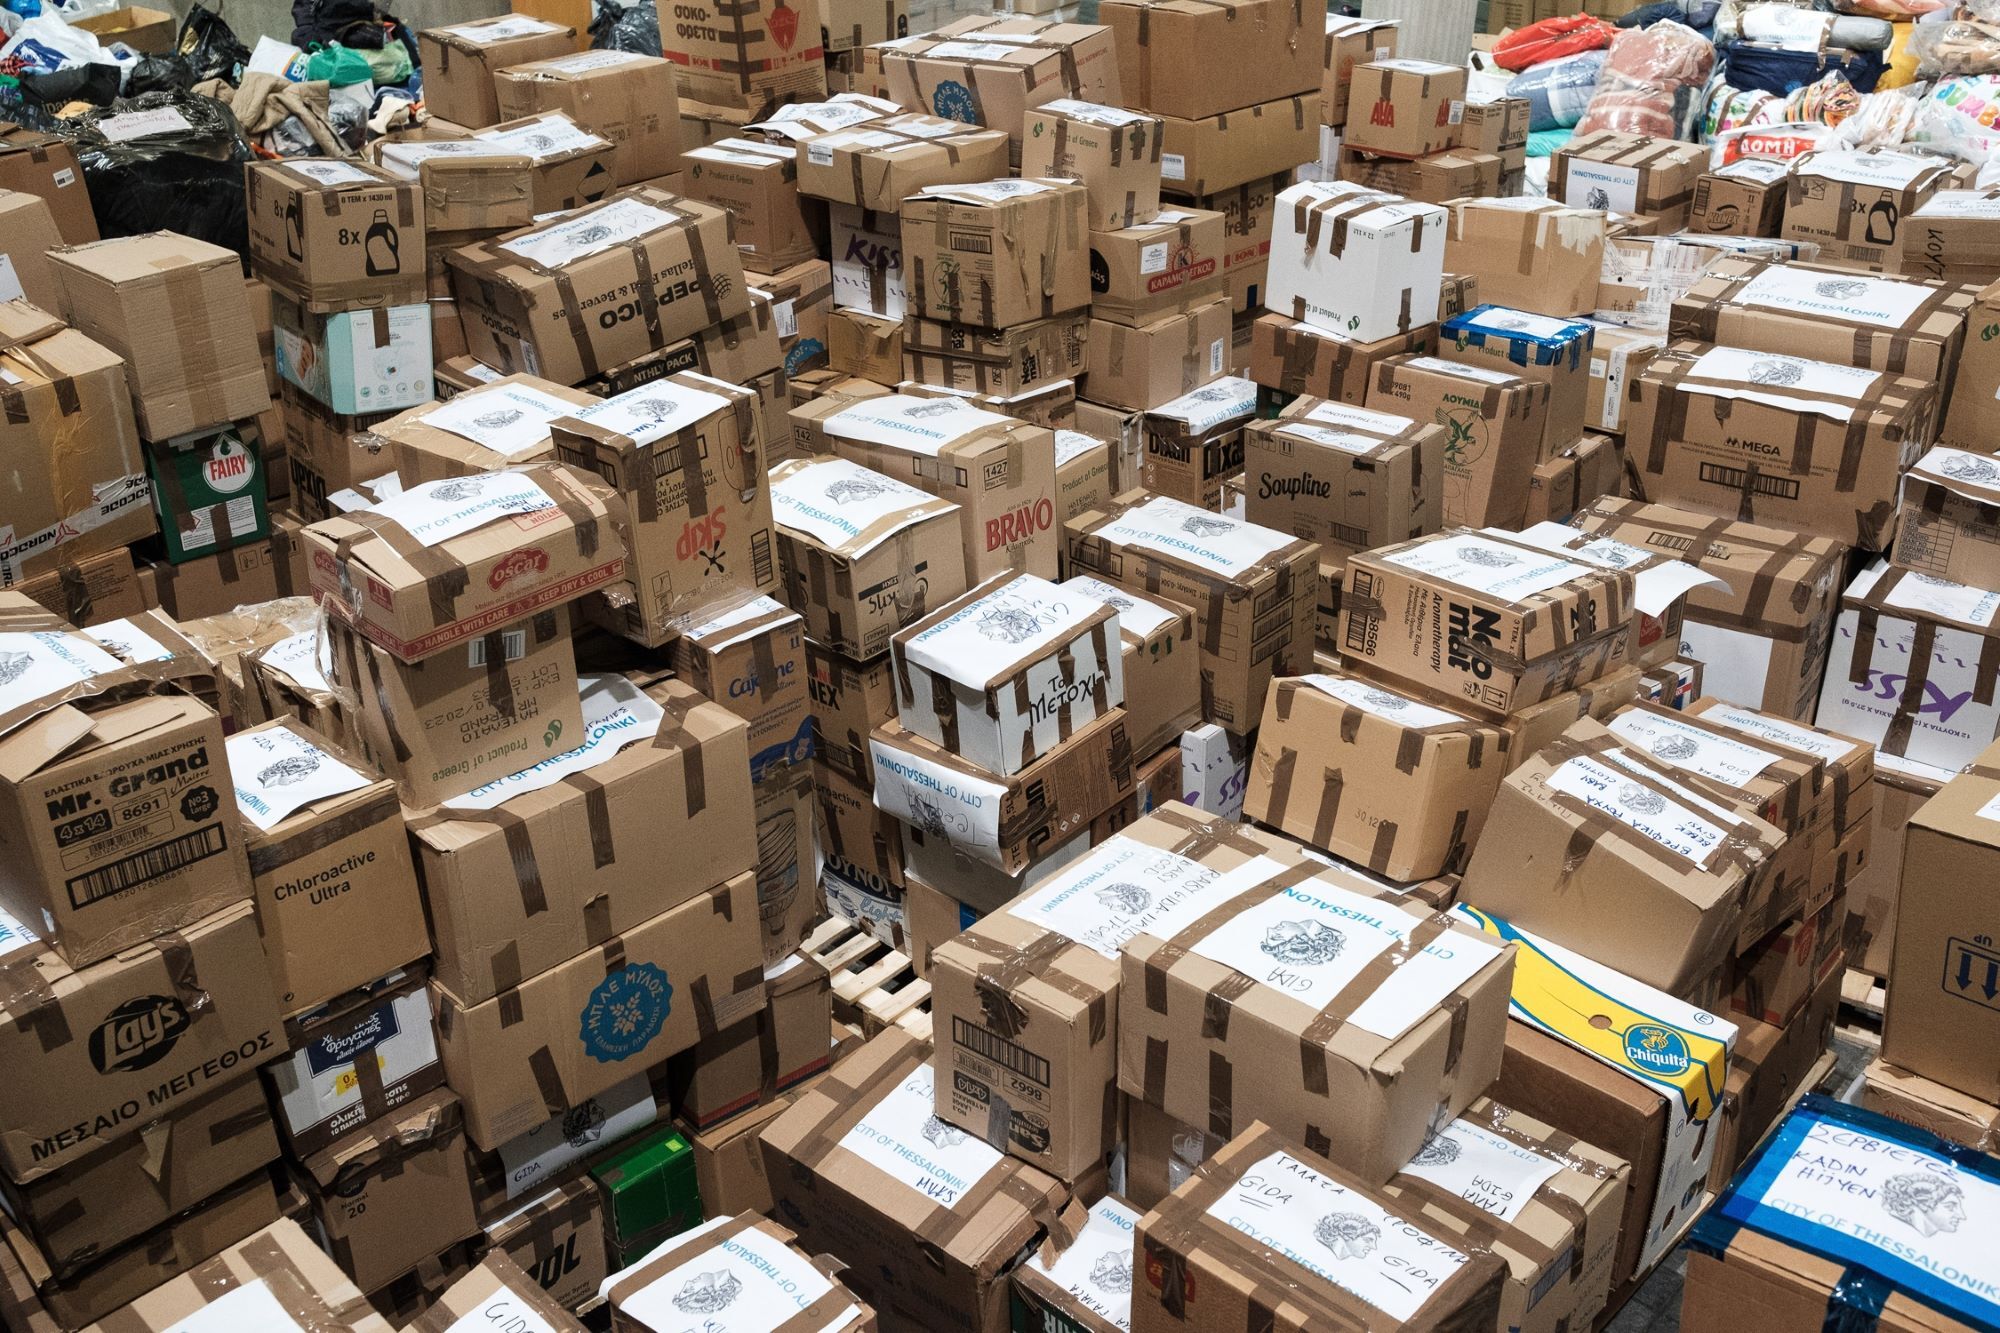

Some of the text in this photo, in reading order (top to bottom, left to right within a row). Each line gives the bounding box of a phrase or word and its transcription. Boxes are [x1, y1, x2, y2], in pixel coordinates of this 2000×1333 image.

[1078, 135, 1099, 149] Greece
[1571, 168, 1635, 186] CITY THESSALONIKI
[339, 228, 360, 245] 8x
[514, 214, 590, 248] THESSALONIKI
[1367, 232, 1375, 240] 12
[1815, 228, 1830, 237] 1430
[1149, 261, 1215, 292] ΚΑΡΑΜΟΕΓΚΟΣ
[599, 279, 705, 330] PEPICO
[617, 287, 628, 301] &
[1746, 292, 1892, 320] CITY OF THESSALONIKI
[1320, 309, 1341, 323] Product
[665, 351, 694, 374] PACK
[860, 415, 873, 428] OF
[873, 416, 948, 440] THESSALONIKI
[1741, 440, 1782, 457] MEGA
[209, 454, 248, 481] FAIRY
[985, 461, 1008, 478] 1427
[1062, 472, 1086, 494] Product
[1258, 471, 1332, 501] Soupline
[434, 488, 543, 529] OF THESSALONIKI
[782, 493, 862, 539] OF THESSALONIK
[985, 498, 1053, 553] BRAVO
[1113, 525, 1234, 567] CITY OF THESSALONIKI
[538, 588, 559, 604] KEEP
[560, 580, 579, 596] DRY
[587, 569, 609, 587] COOL
[1008, 574, 1029, 594] CITY
[1484, 576, 1523, 595] CITY OF
[424, 607, 511, 650] HANDLE WITH CARE
[916, 595, 994, 644] THESSALONIKI
[1431, 592, 1444, 674] Aromatherapy
[531, 671, 561, 692] EXP:
[1929, 723, 1960, 738] ΚΟΥΤΙΑ
[470, 714, 638, 798] CITY OF THESSALONIKI
[488, 737, 528, 765] Product
[44, 774, 92, 798] ΕΛΑΣΤΙΚΑ
[146, 750, 169, 766] ΜΙΑΣ
[168, 735, 208, 760] ΧΡΗΣΗΣ
[431, 759, 471, 784] Greece
[875, 752, 944, 794] THESSALONIKI
[1568, 758, 1617, 786] CLOTHES
[47, 748, 210, 821] Mr. Grand
[944, 782, 960, 799] OF
[1578, 775, 1609, 793] BABY
[121, 798, 162, 822] 8691
[960, 789, 984, 810] CITY
[58, 814, 108, 841] 4x14
[273, 849, 376, 899] Chloroactive
[309, 878, 351, 907] Ultra
[1041, 871, 1104, 914] THESSALONIKI
[1973, 934, 1993, 948] UP
[1265, 967, 1313, 993] GIDA
[587, 971, 665, 1029] ΜΠΛΕ ΜΥΛΟΣ
[1626, 1044, 1689, 1070] Chiquita
[31, 1030, 275, 1162] ΜΕΣΑΙΟ ΜΕΓΕΘΟΣ
[1010, 1076, 1043, 1101] 8662
[331, 1127, 341, 1137] 10
[855, 1121, 968, 1191] CITY OF THESSALONIKI
[1513, 1147, 1541, 1164] CITY
[1794, 1149, 1869, 1178] KADIN
[512, 1160, 543, 1184] GIDA
[340, 1192, 370, 1210] Normal
[1238, 1174, 1293, 1205] GIDA
[1471, 1174, 1515, 1201] GIDA
[347, 1203, 368, 1221] 20
[1769, 1196, 1818, 1222] CITY
[1822, 1211, 1851, 1230] OF
[1227, 1215, 1279, 1250] CITY OF
[775, 1274, 793, 1295] OF
[1382, 1254, 1440, 1290] GIDA
